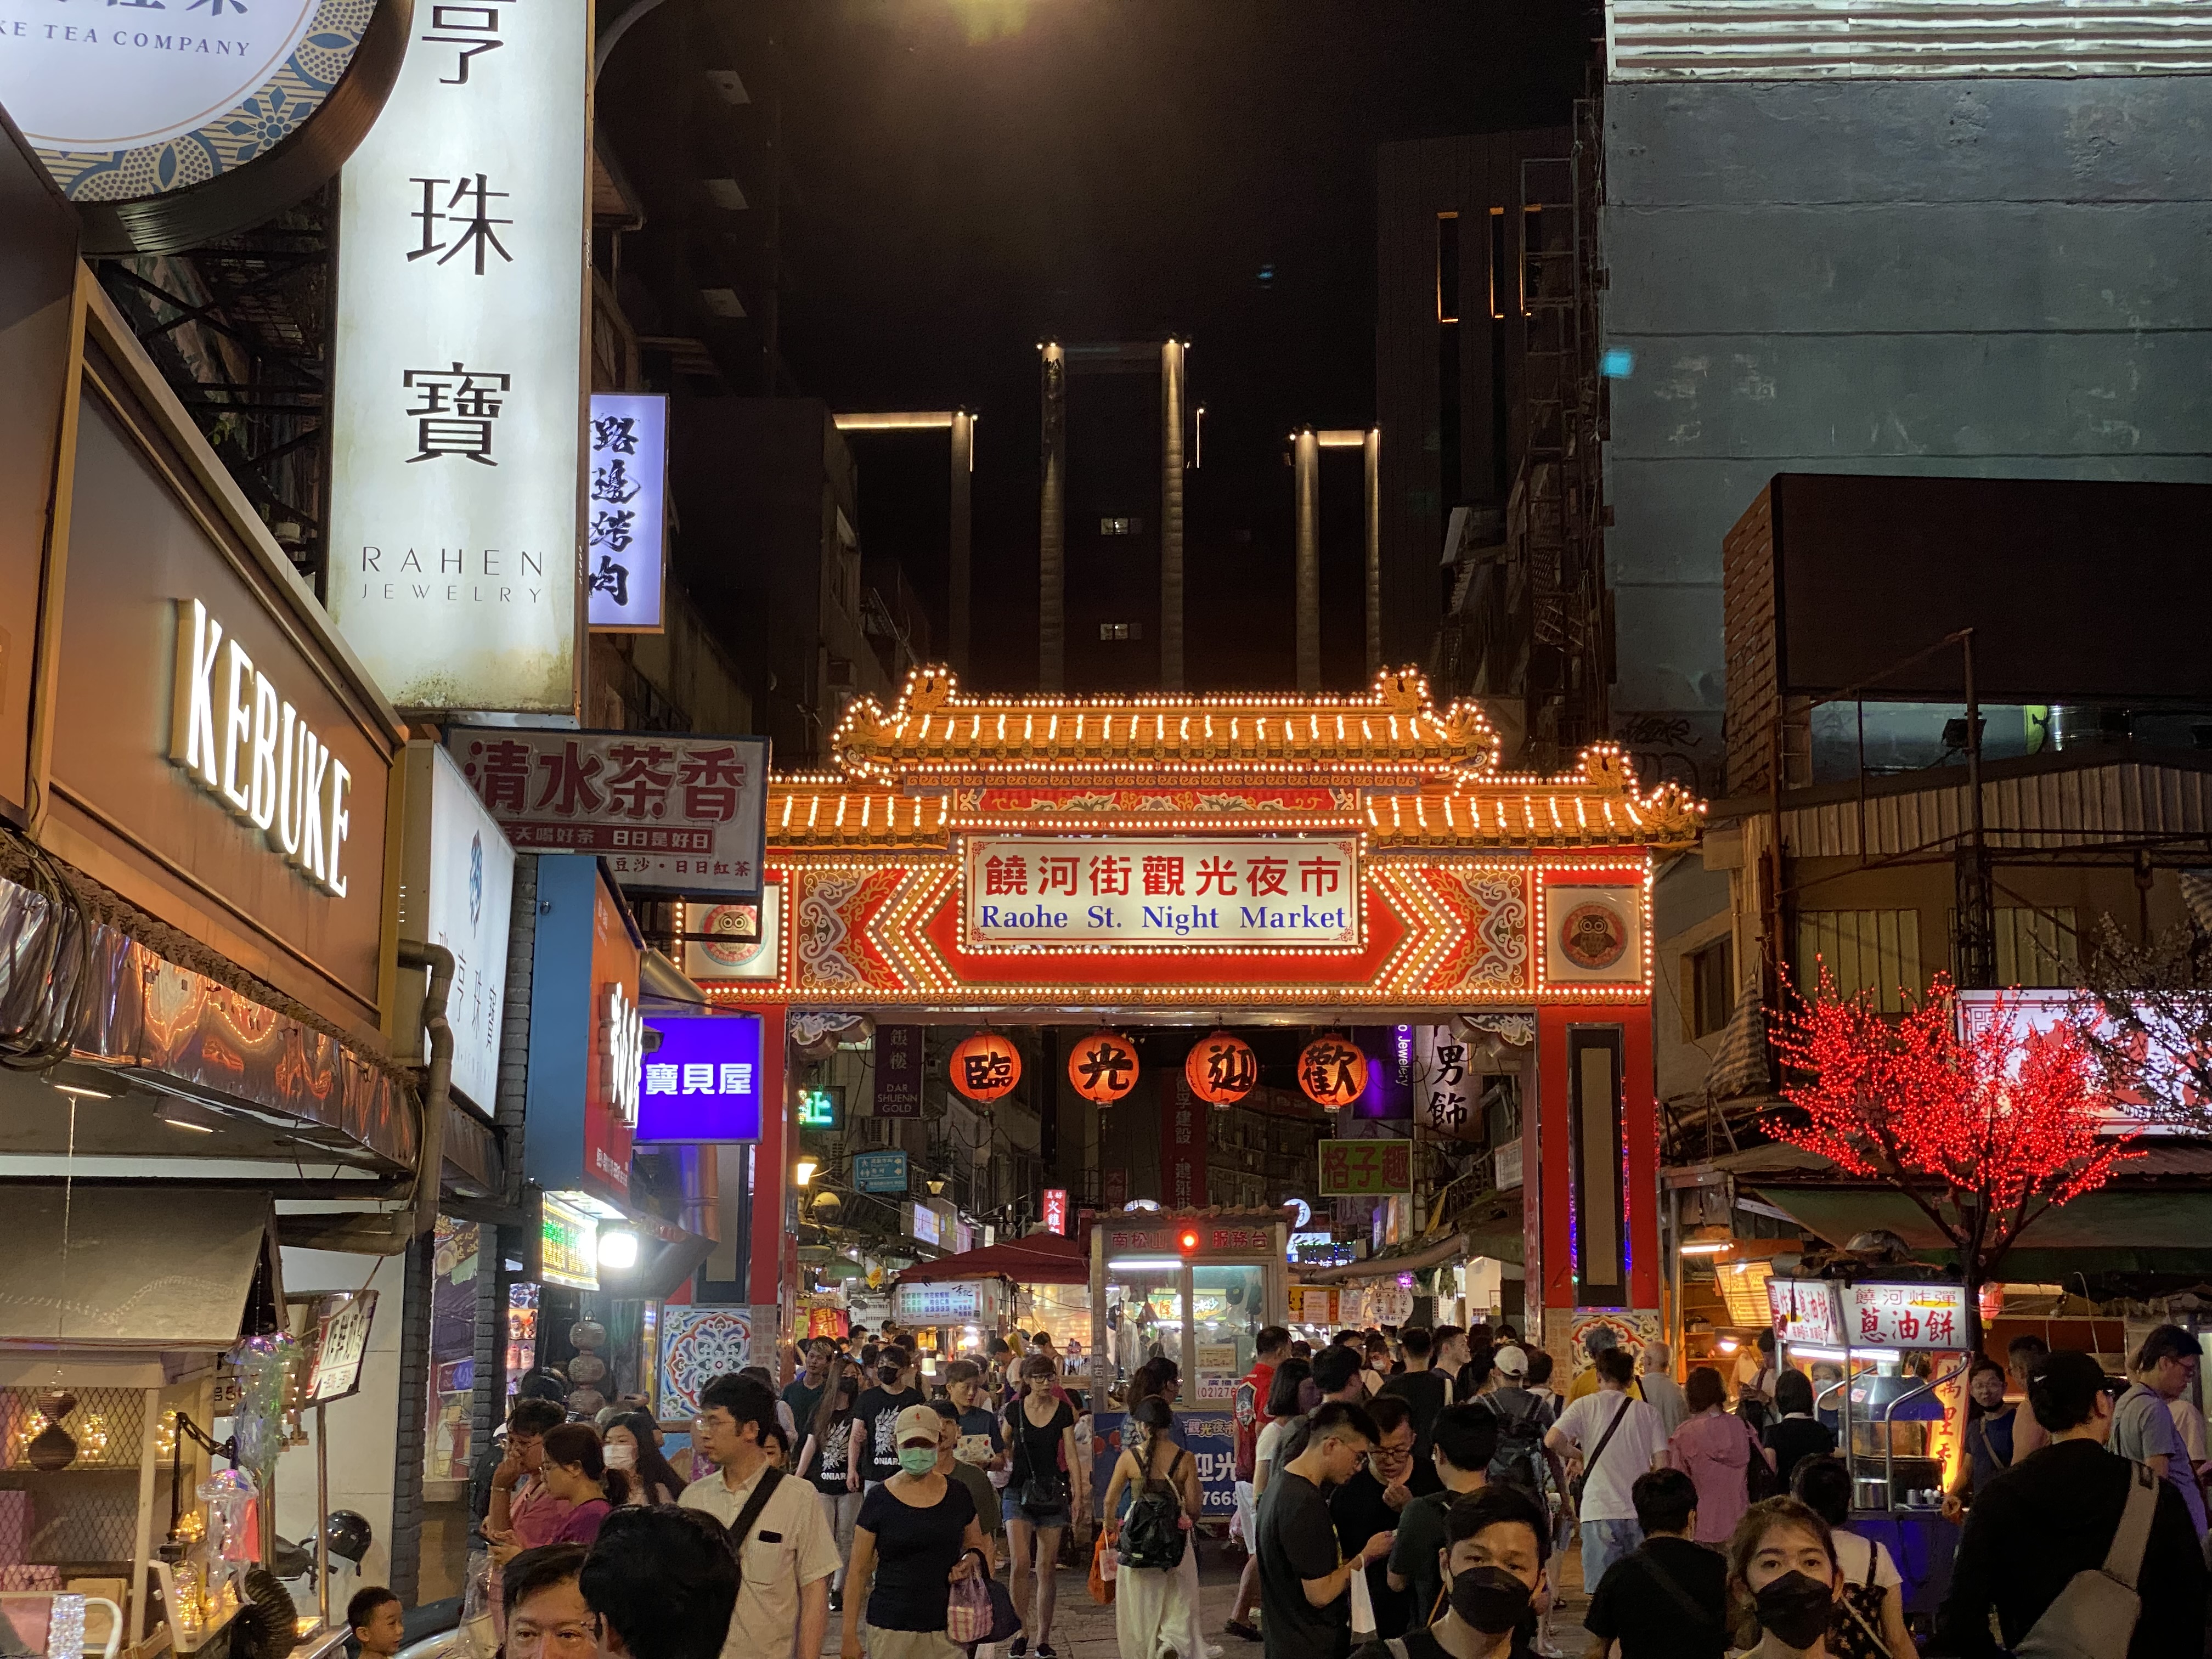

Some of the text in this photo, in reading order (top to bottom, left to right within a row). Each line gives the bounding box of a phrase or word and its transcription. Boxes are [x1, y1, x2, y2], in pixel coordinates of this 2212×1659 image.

[43, 24, 98, 43] TEA
[113, 31, 251, 57] COMPANY
[362, 546, 543, 577] RAHEN
[362, 584, 541, 603] JEWELRY
[187, 598, 352, 899] KEBUKE
[465, 740, 746, 822] 清水茶香
[613, 830, 709, 850] 日日是好日
[985, 855, 1341, 897] 饒河街觀光夜市
[981, 905, 1346, 935] Raohe St. Night Market
[645, 1063, 752, 1095] 寶貝屋
[963, 1051, 1014, 1090] 臨
[1078, 1043, 1133, 1090] 光
[1207, 1045, 1257, 1092] 迎
[878, 1094, 918, 1103] SHUENN
[887, 1084, 908, 1092] DAR
[1427, 1045, 1468, 1133] 男飾
[882, 1104, 912, 1113] GOLD
[1111, 1230, 1268, 1249] 南松山 服務台
[1855, 1288, 1956, 1306] 饒河炸彈
